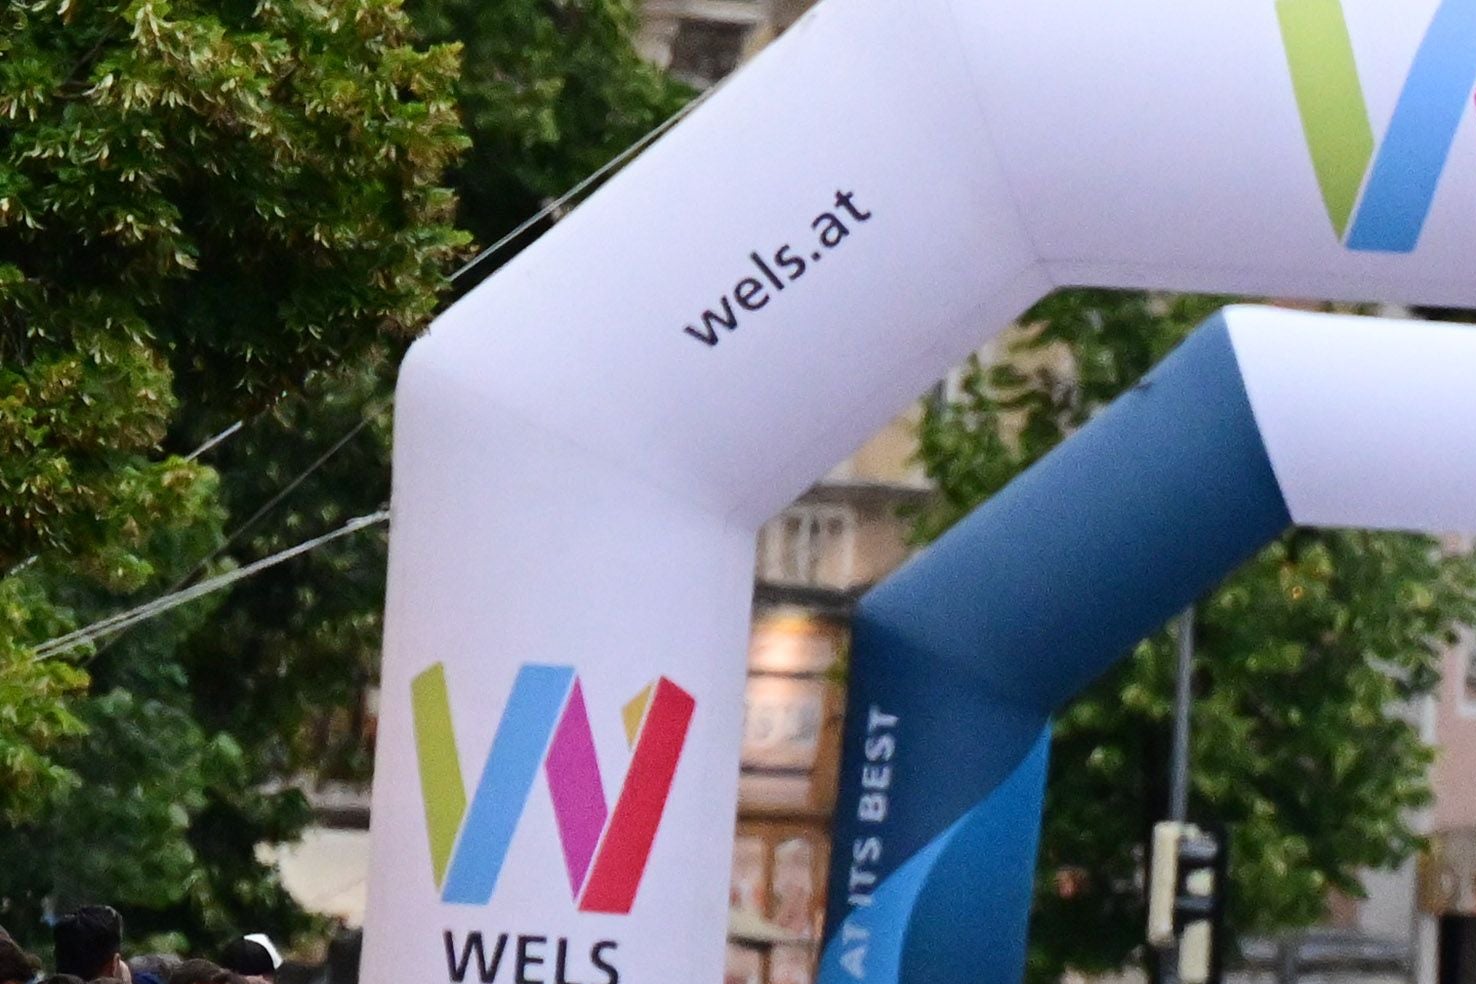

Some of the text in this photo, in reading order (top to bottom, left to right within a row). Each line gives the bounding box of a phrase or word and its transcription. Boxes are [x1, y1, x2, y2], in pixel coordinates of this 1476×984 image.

[684, 189, 872, 347] wels.at
[857, 704, 901, 823] BEST
[847, 836, 883, 908] ITS
[840, 922, 870, 980] AT
